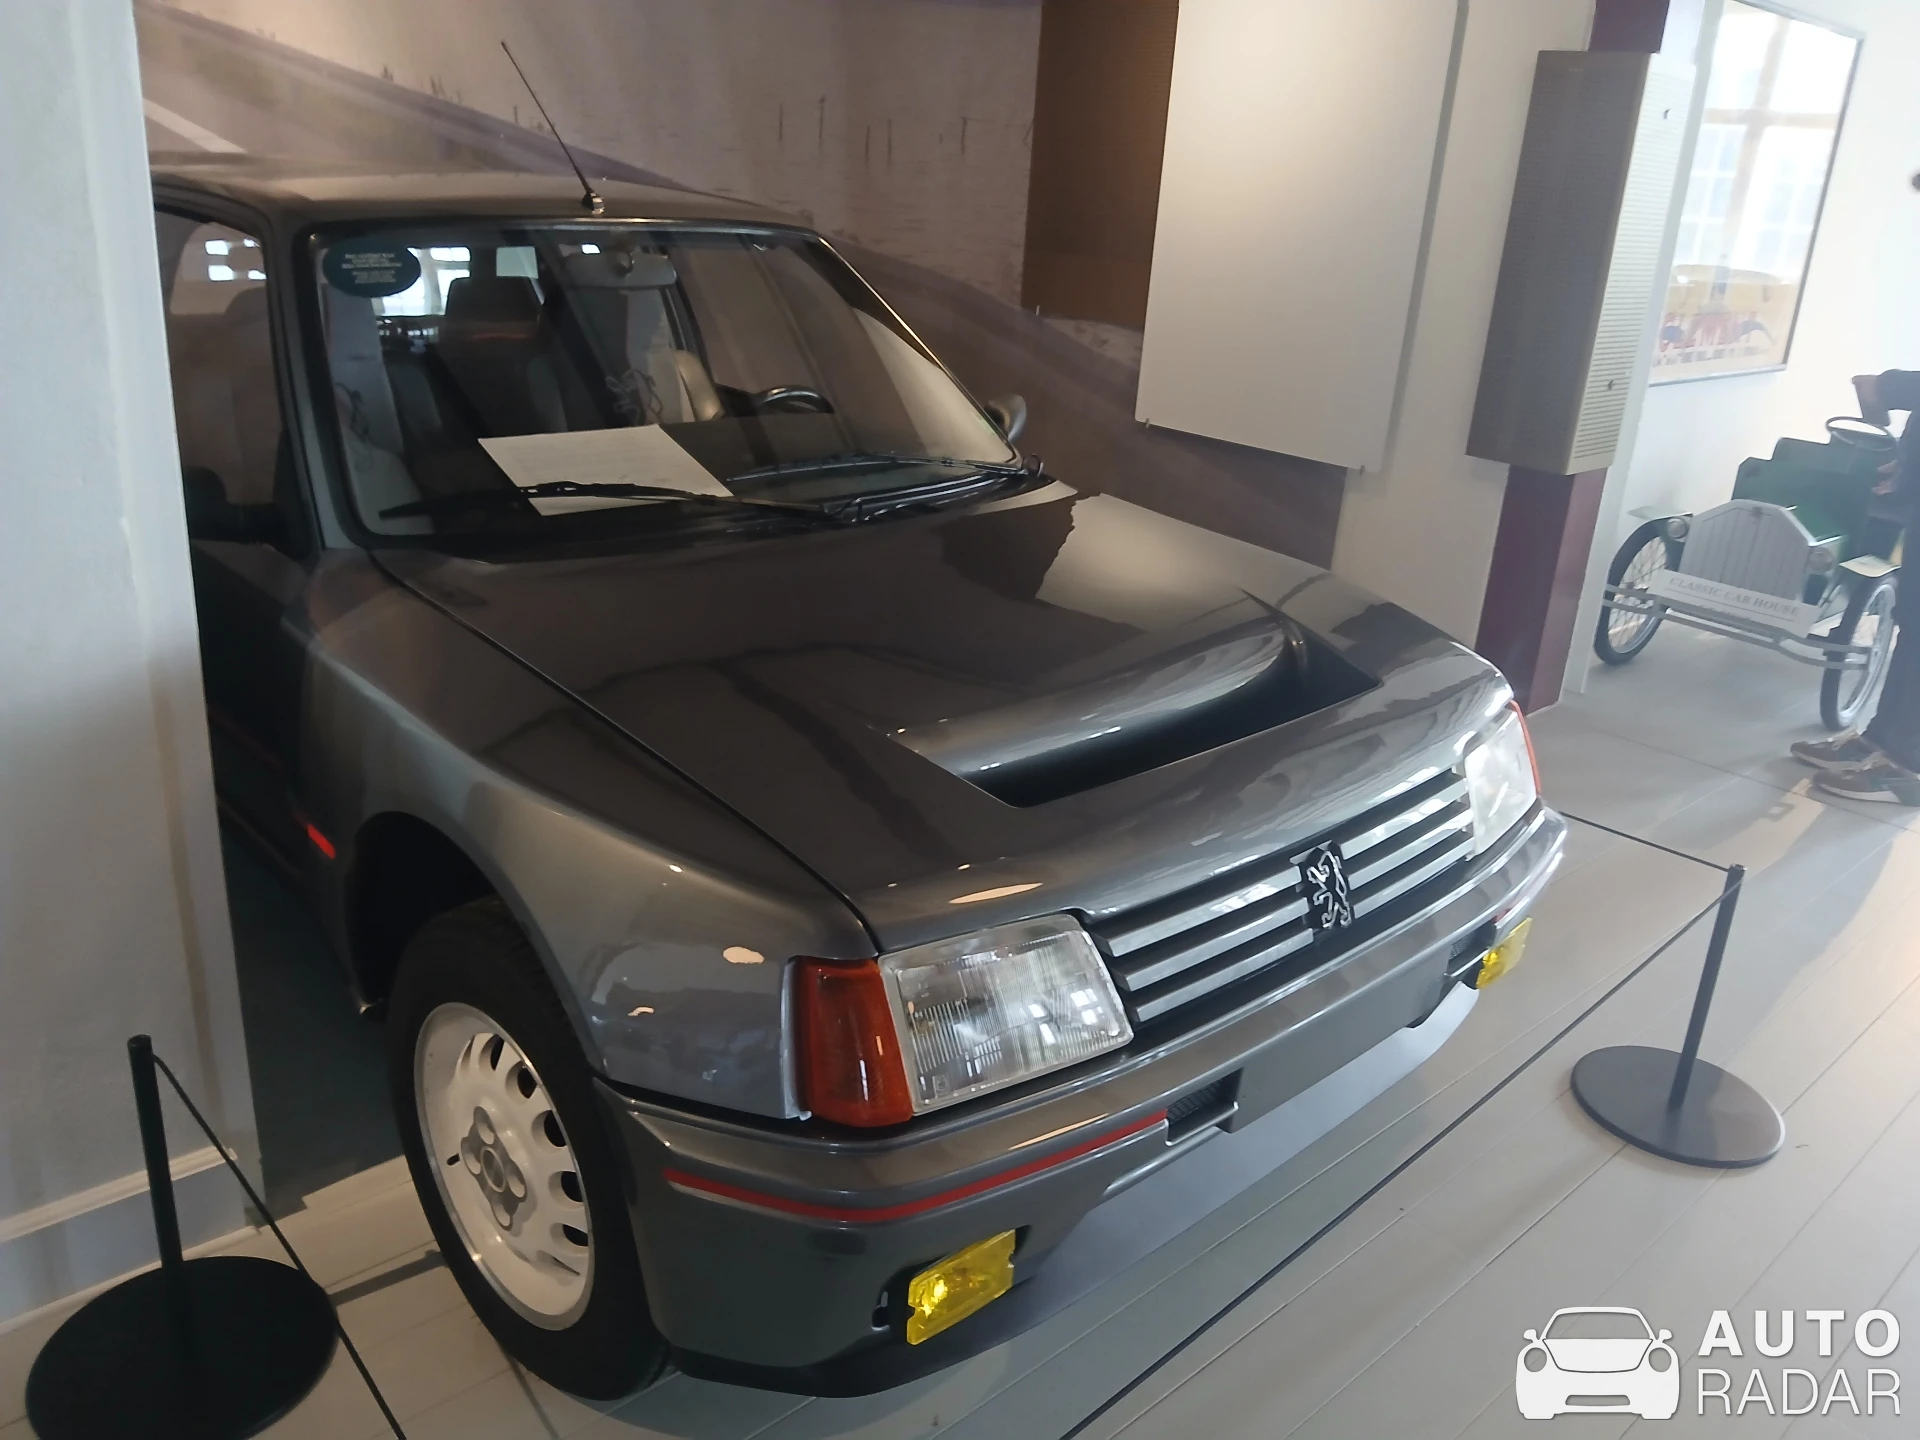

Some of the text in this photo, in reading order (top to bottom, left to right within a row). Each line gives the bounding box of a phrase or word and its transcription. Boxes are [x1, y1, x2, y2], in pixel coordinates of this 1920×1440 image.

[1669, 577, 1800, 616] CLASSIC CAR HOUSE
